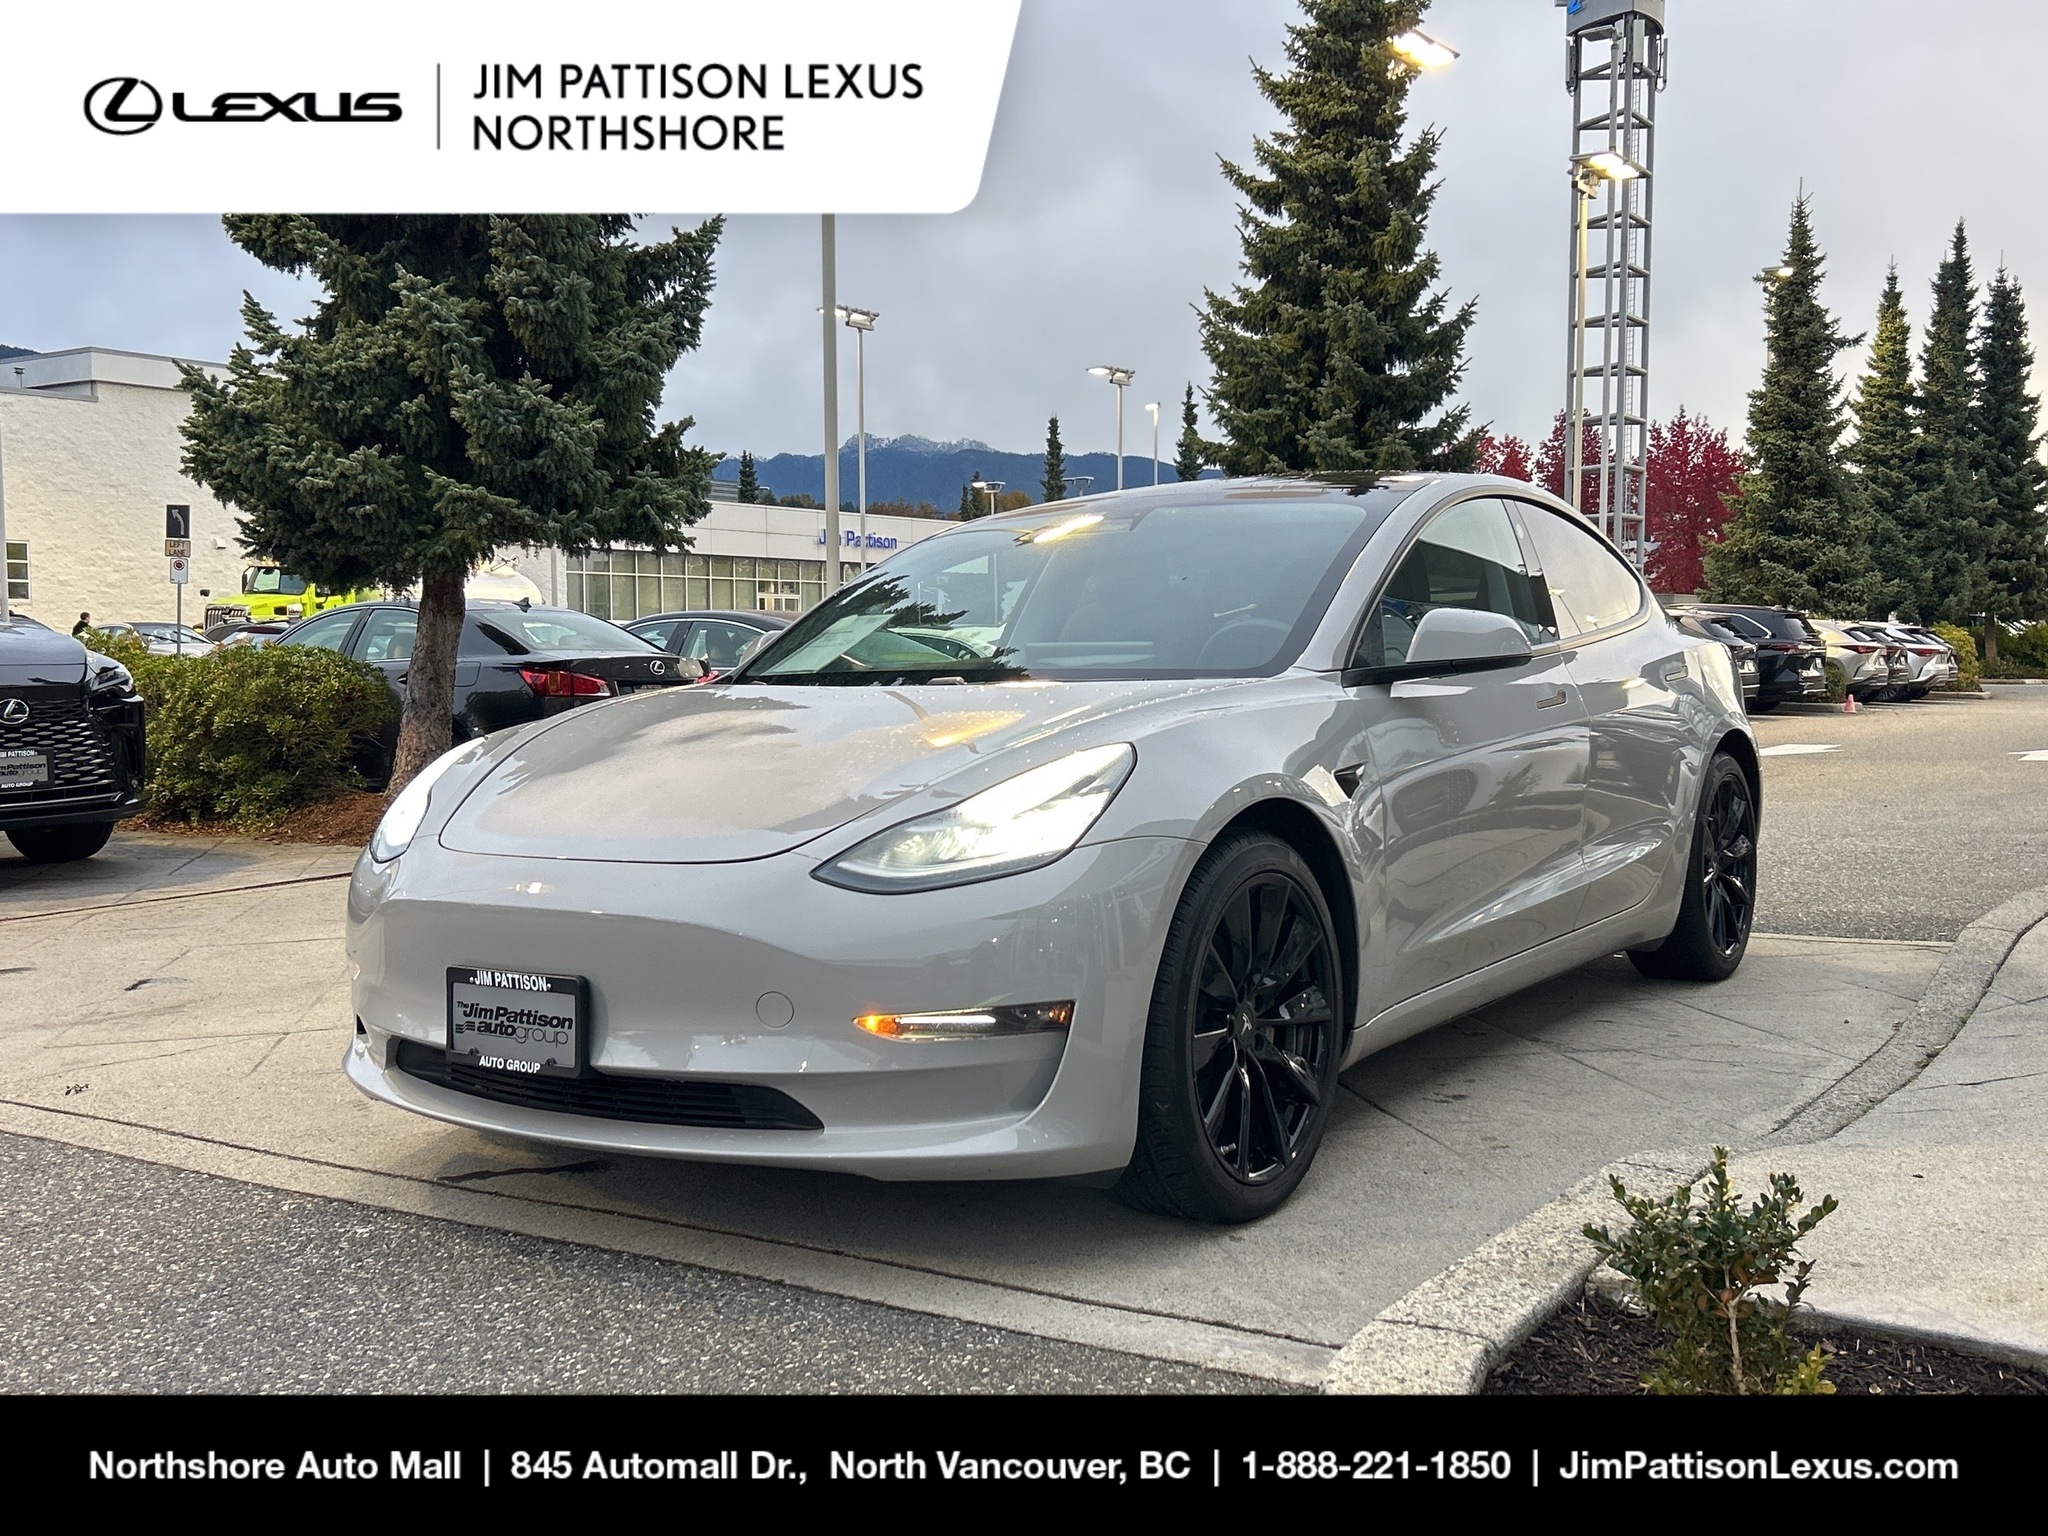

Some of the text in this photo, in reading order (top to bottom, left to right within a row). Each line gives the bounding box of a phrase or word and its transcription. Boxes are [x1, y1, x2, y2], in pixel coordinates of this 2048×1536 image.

[846, 530, 898, 550] Patison
[8, 750, 35, 758] PATTISON
[474, 970, 547, 991] JIM PATTISON
[456, 1001, 470, 1009] The
[479, 1056, 541, 1074] AUTO GROUP
